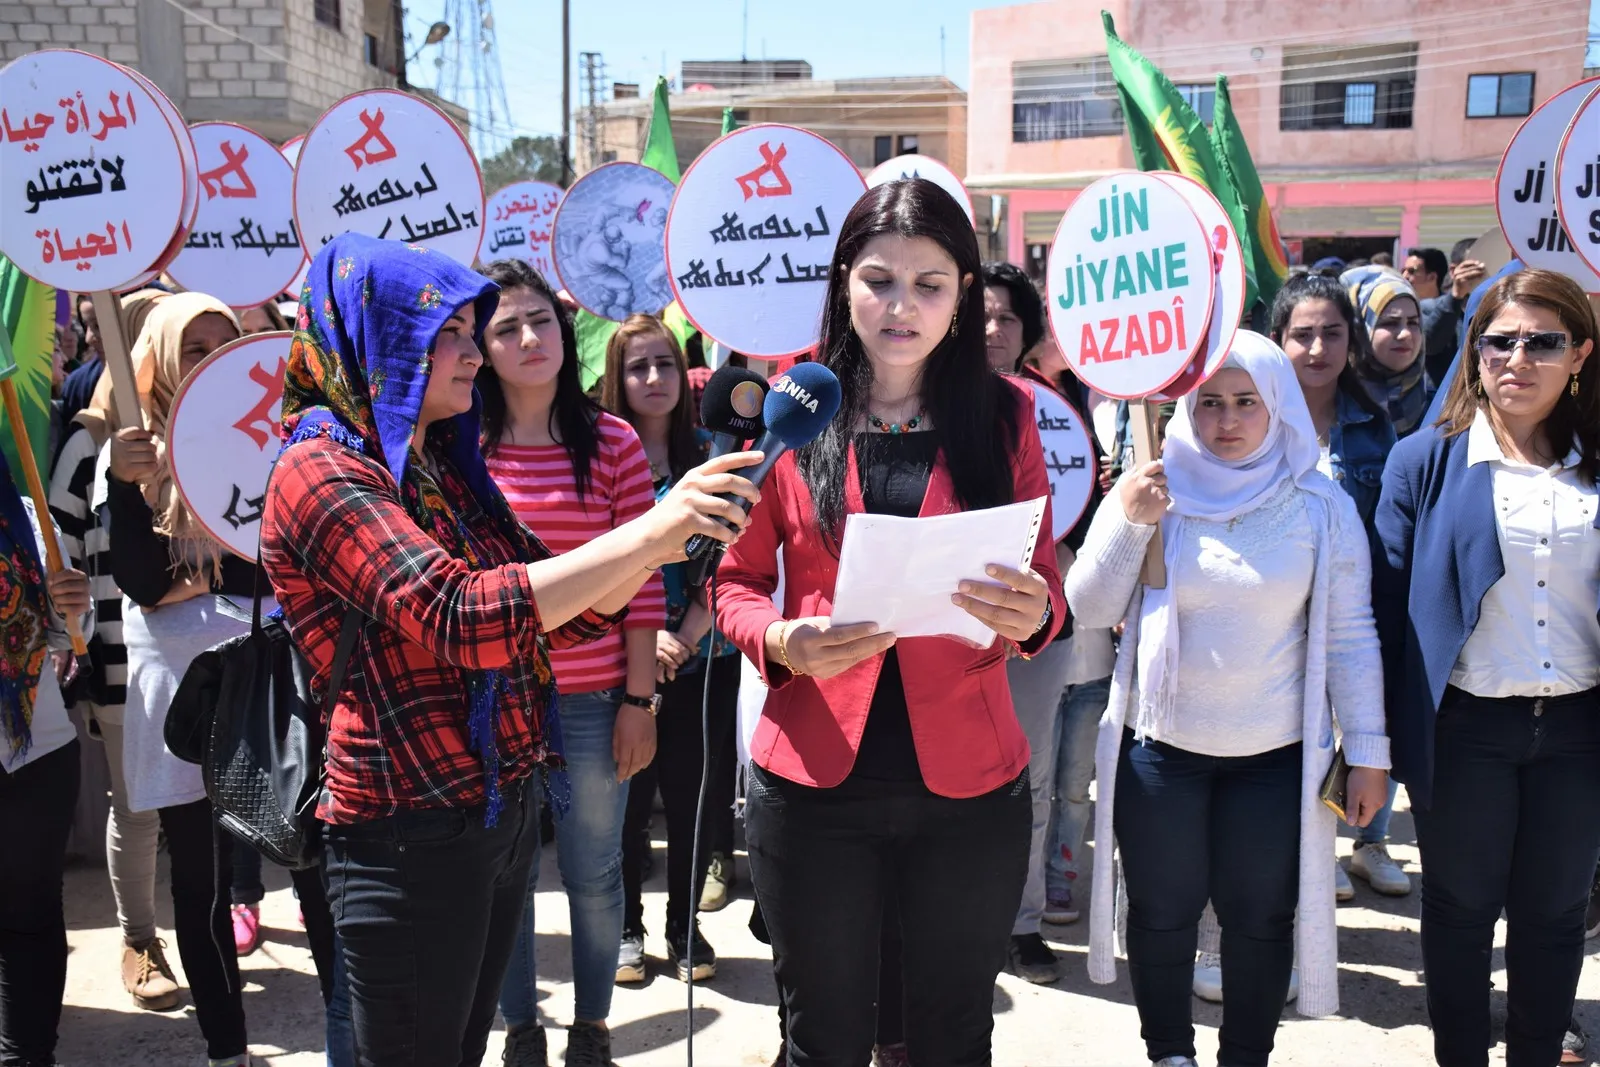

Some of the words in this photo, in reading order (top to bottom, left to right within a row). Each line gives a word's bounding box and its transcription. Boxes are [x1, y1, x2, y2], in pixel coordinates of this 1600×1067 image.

[58, 90, 137, 142] المرأة
[35, 219, 132, 272] الحياة
[489, 226, 526, 253] تقتل
[1079, 295, 1188, 366] AZADÎ
